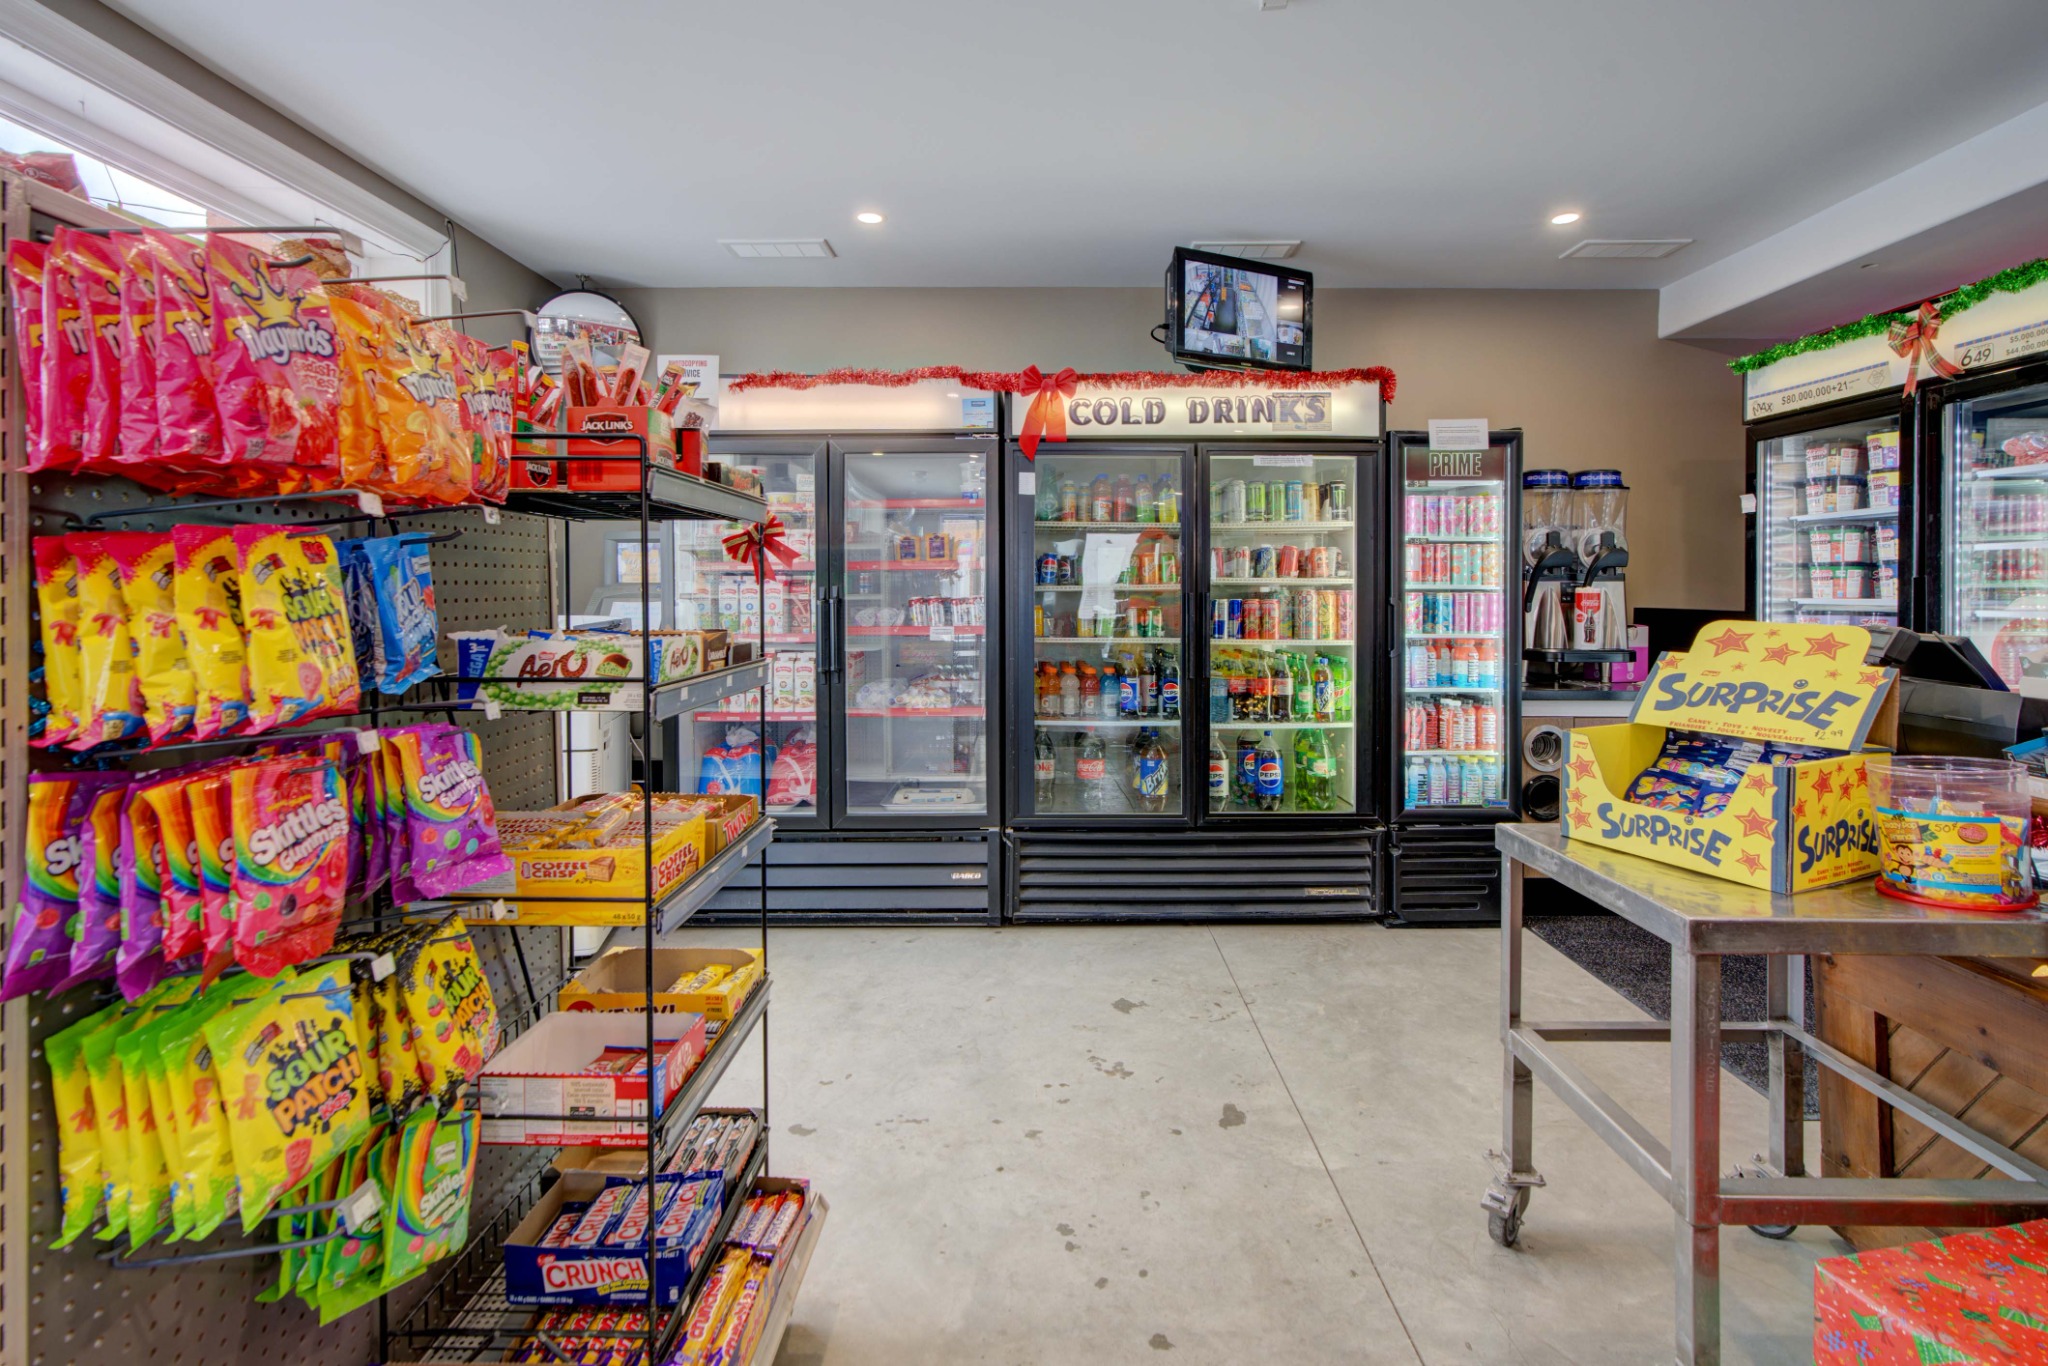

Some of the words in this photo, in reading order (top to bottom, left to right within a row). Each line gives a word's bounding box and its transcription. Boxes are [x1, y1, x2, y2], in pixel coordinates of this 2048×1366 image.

[1960, 348, 1992, 367] 649
[1069, 397, 1166, 426] COLD
[1186, 395, 1326, 424] DRINKS
[1753, 402, 1773, 416] MAX
[581, 420, 605, 431] JACK
[1429, 452, 1482, 477] PRIME
[283, 590, 337, 623] SOUR
[517, 650, 588, 688] Aero
[1654, 672, 1861, 731] SURPRISE
[1716, 727, 1746, 736] JOUETS
[1722, 721, 1742, 729] TOYS
[1752, 725, 1788, 734] NOVELTY
[1815, 729, 1844, 741] $2.99
[1035, 761, 1053, 770] oke
[419, 760, 481, 803] Skittles
[249, 798, 347, 865] Skittles
[1597, 802, 1732, 867] SURPRISE
[1798, 818, 1879, 874] SURPRISE
[532, 862, 588, 870] COFFEE
[532, 869, 577, 878] CRISP
[658, 843, 692, 875] COFFEE
[658, 859, 687, 889] CRISP
[266, 1029, 350, 1101] SOUR
[273, 1050, 362, 1136] PATCH
[574, 1186, 620, 1243] CRUNCH
[660, 1182, 698, 1236] CRUNCH
[545, 1261, 644, 1288] CRUNCH
